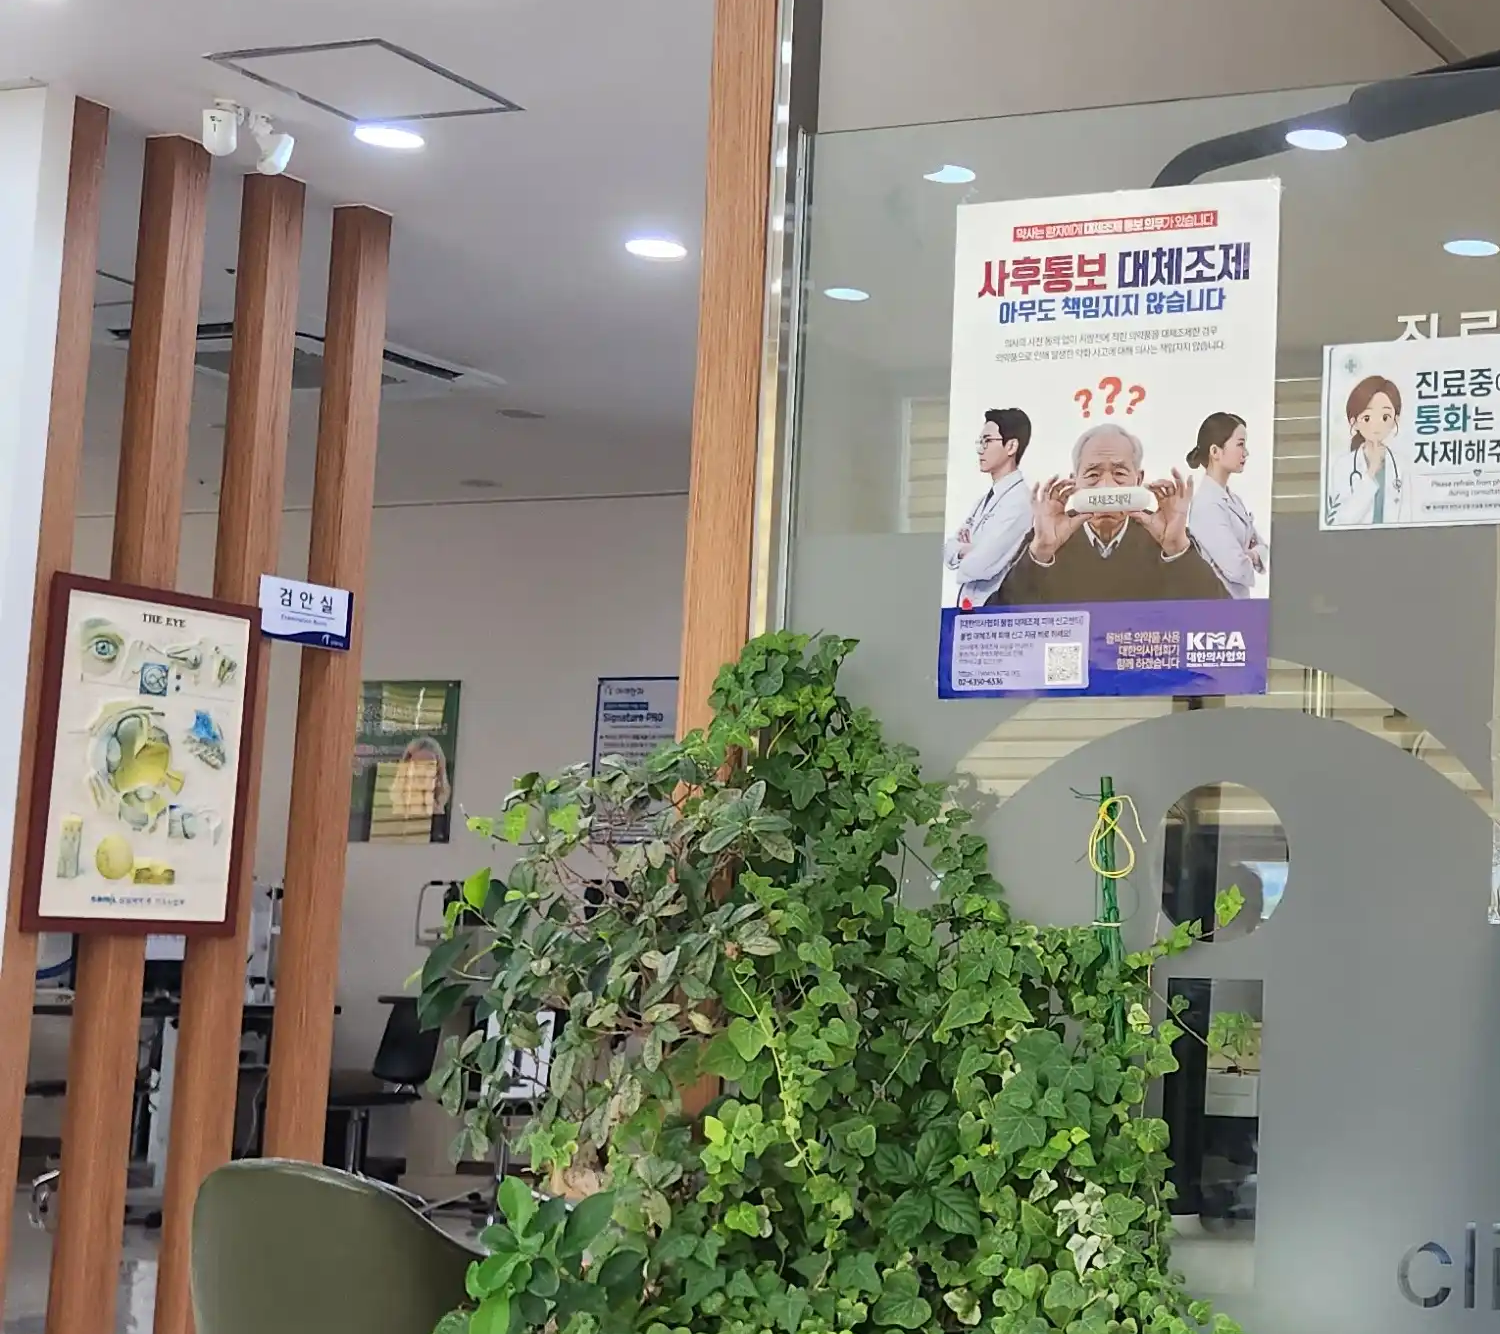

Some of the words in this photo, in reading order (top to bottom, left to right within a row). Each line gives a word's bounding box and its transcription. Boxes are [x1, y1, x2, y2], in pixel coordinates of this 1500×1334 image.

[977, 252, 1108, 299] 사후통보
[1117, 241, 1251, 289] 대체조제
[999, 298, 1057, 324] 아무도
[1061, 293, 1140, 319] 책임지지
[1146, 286, 1227, 316] 않습니다
[1414, 402, 1494, 434] 통화는
[1431, 479, 1452, 488] Please
[1453, 479, 1475, 488] refrain
[1475, 478, 1492, 487] from
[1448, 488, 1470, 497] during
[142, 612, 164, 626] THE
[165, 616, 187, 629] EYE
[1162, 630, 1180, 644] 사용
[1186, 631, 1247, 651] KMA
[1186, 650, 1246, 663] 대한의사협회
